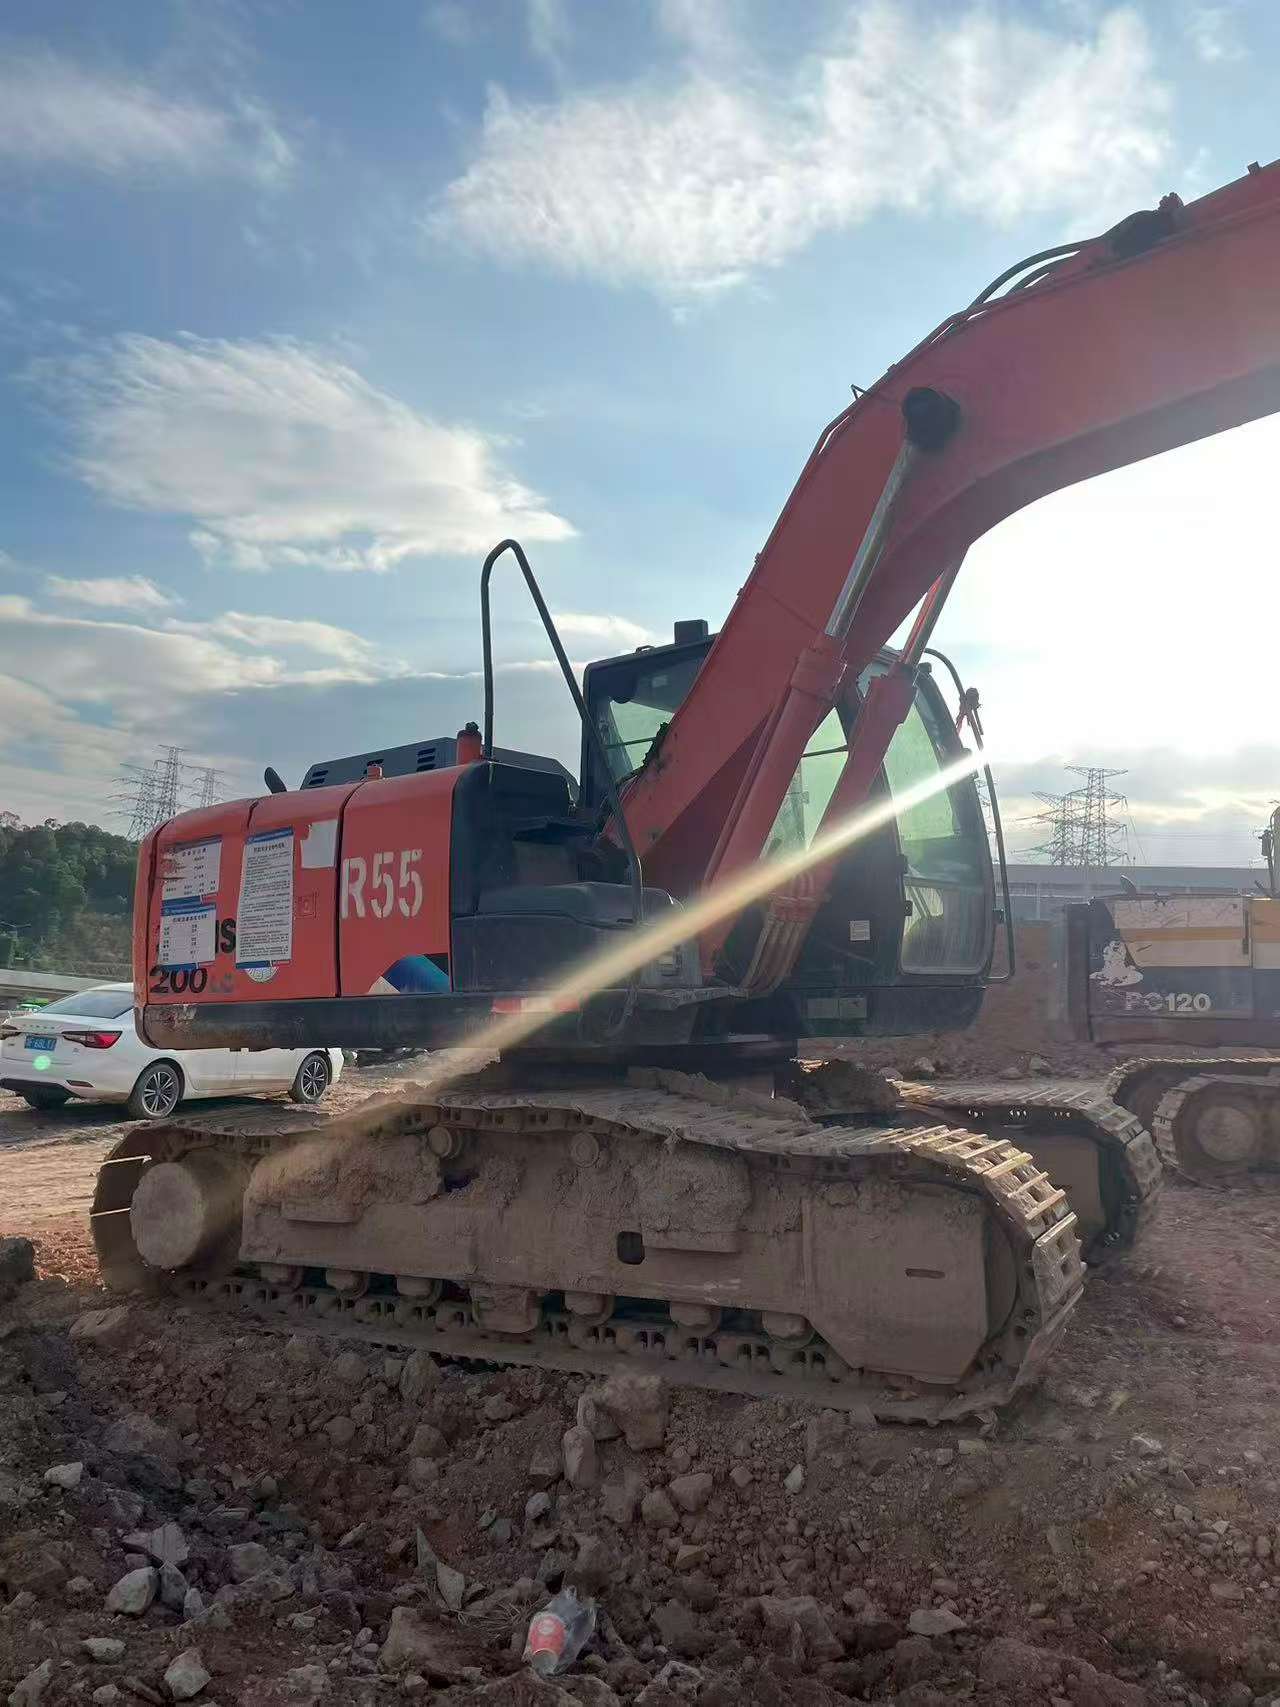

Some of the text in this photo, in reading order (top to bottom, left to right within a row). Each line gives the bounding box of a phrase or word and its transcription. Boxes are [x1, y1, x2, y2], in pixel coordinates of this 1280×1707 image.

[341, 849, 423, 918] R55
[149, 964, 208, 994] 200
[1124, 992, 1211, 1012] PC120
